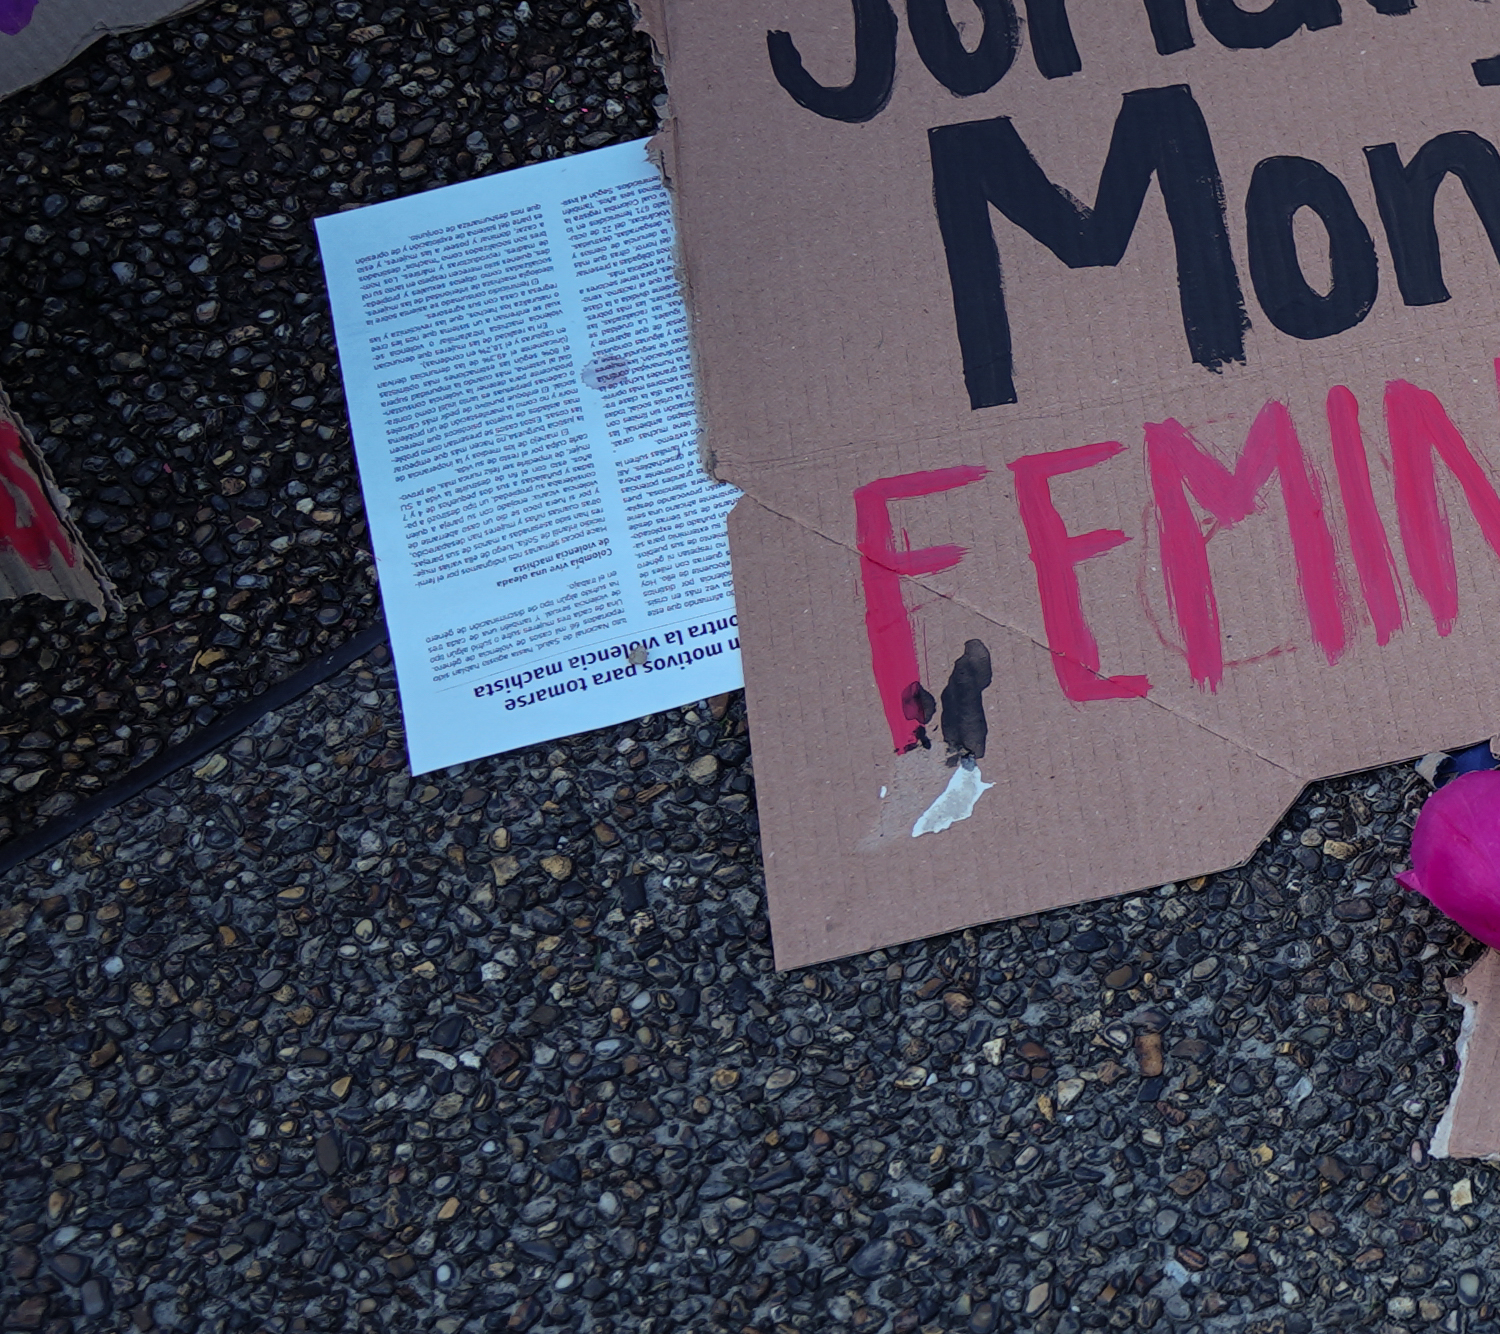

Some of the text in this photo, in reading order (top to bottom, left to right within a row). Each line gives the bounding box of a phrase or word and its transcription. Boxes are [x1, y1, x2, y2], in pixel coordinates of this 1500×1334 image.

[664, 629, 683, 645] la
[687, 614, 738, 637] ontra
[642, 642, 722, 673] motivos
[473, 661, 562, 697] machista
[591, 663, 636, 685] para
[504, 677, 587, 710] tomarse
